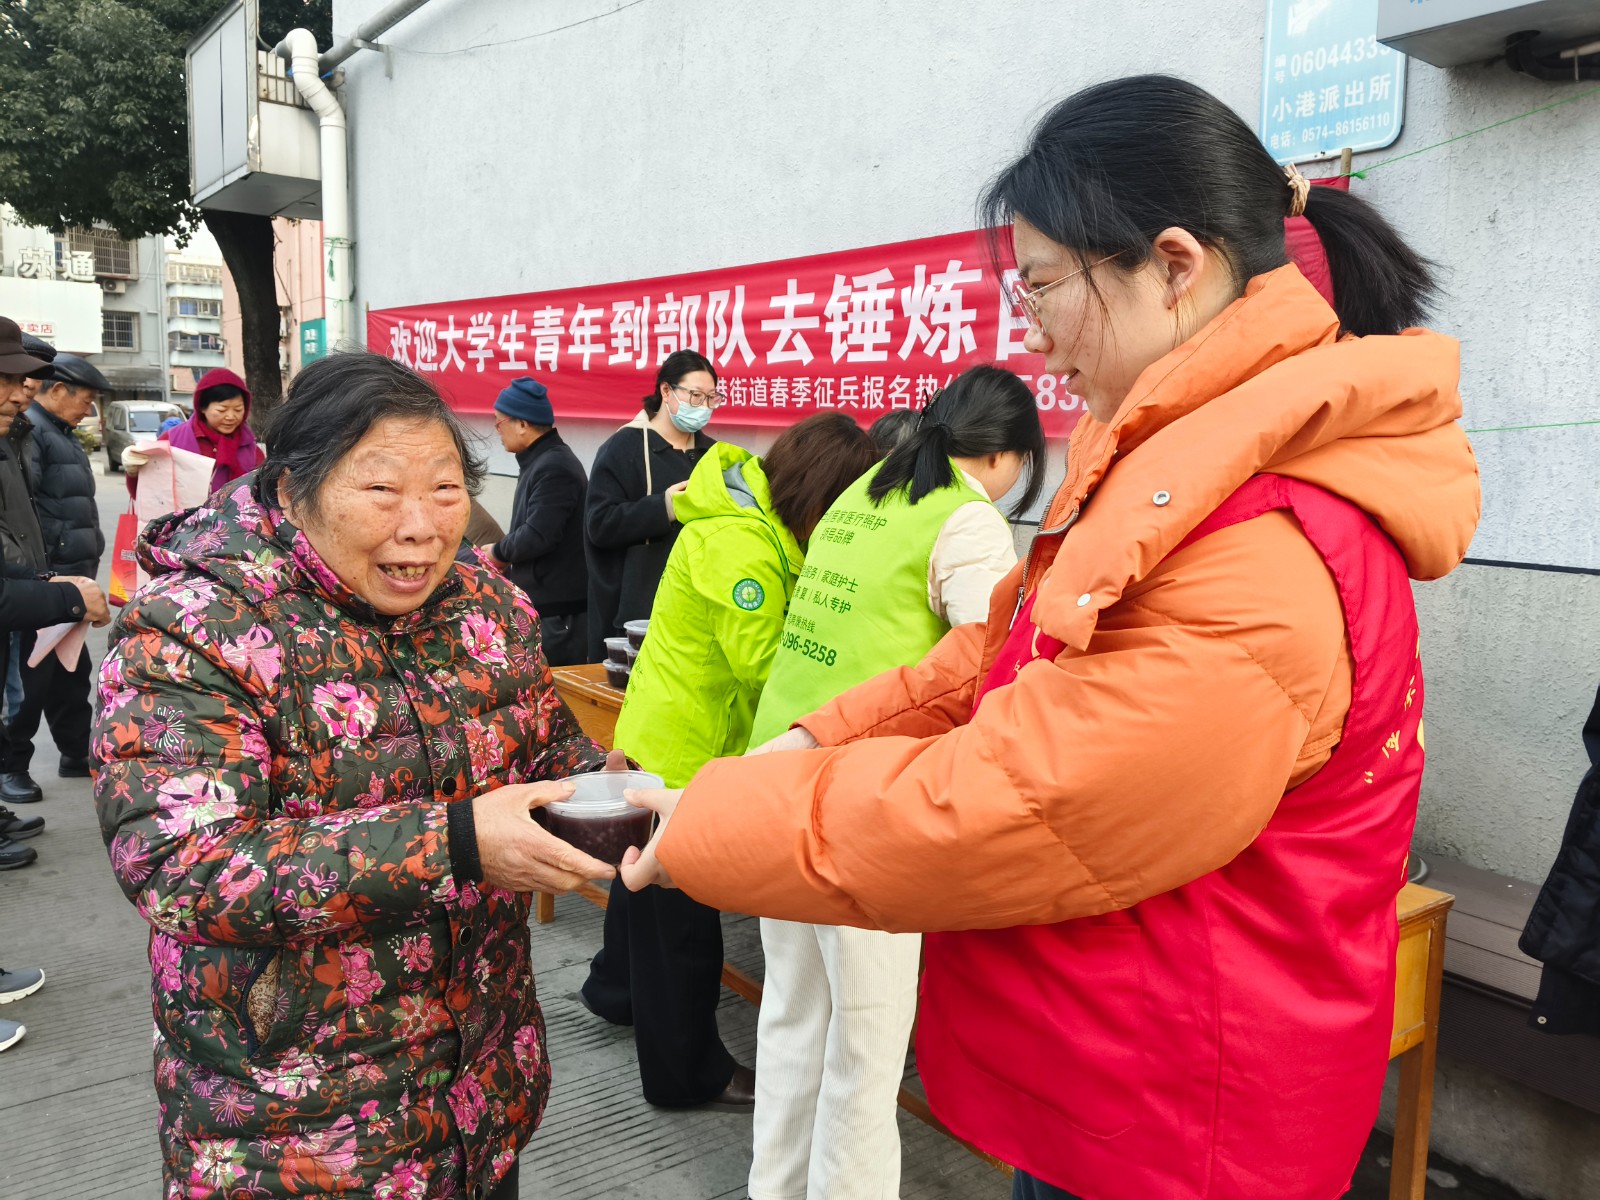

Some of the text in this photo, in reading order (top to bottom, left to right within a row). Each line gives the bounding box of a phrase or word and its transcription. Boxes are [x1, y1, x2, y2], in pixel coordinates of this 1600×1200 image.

[1272, 73, 1391, 122] 小港派出所
[813, 590, 852, 614] 私人专护
